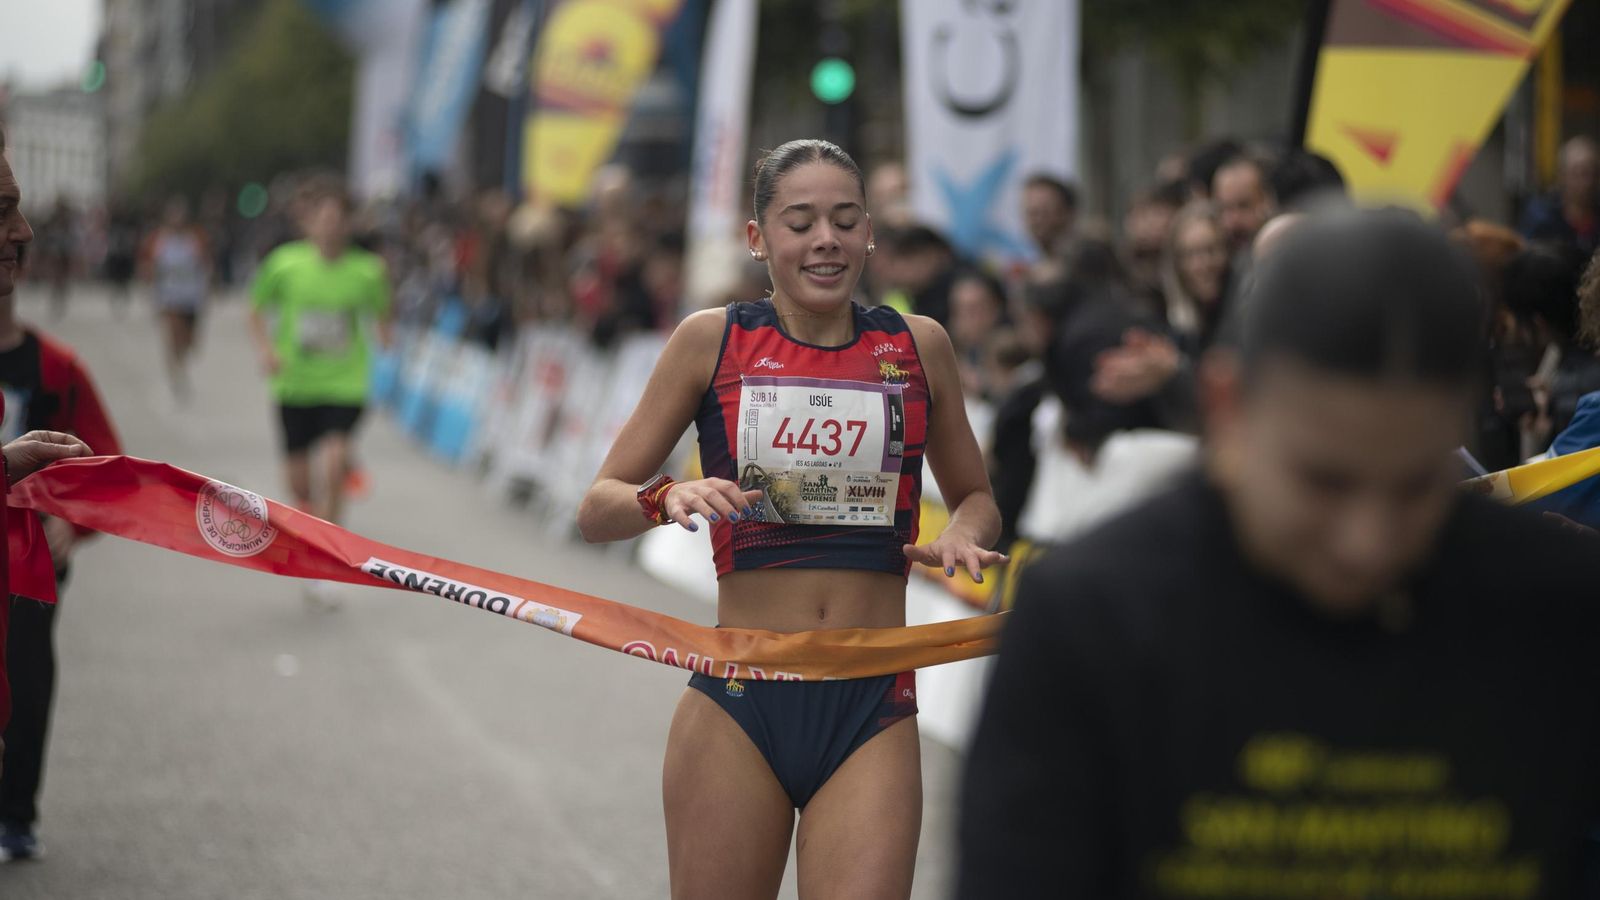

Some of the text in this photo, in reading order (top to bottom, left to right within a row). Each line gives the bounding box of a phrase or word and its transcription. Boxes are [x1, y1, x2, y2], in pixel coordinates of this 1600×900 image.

[750, 391, 777, 403] SUB 16
[809, 394, 833, 407] USÚE
[772, 417, 868, 457] 4437
[848, 485, 886, 498] XLVIII
[206, 525, 218, 538] DE
[218, 536, 263, 551] MUNICIPAL
